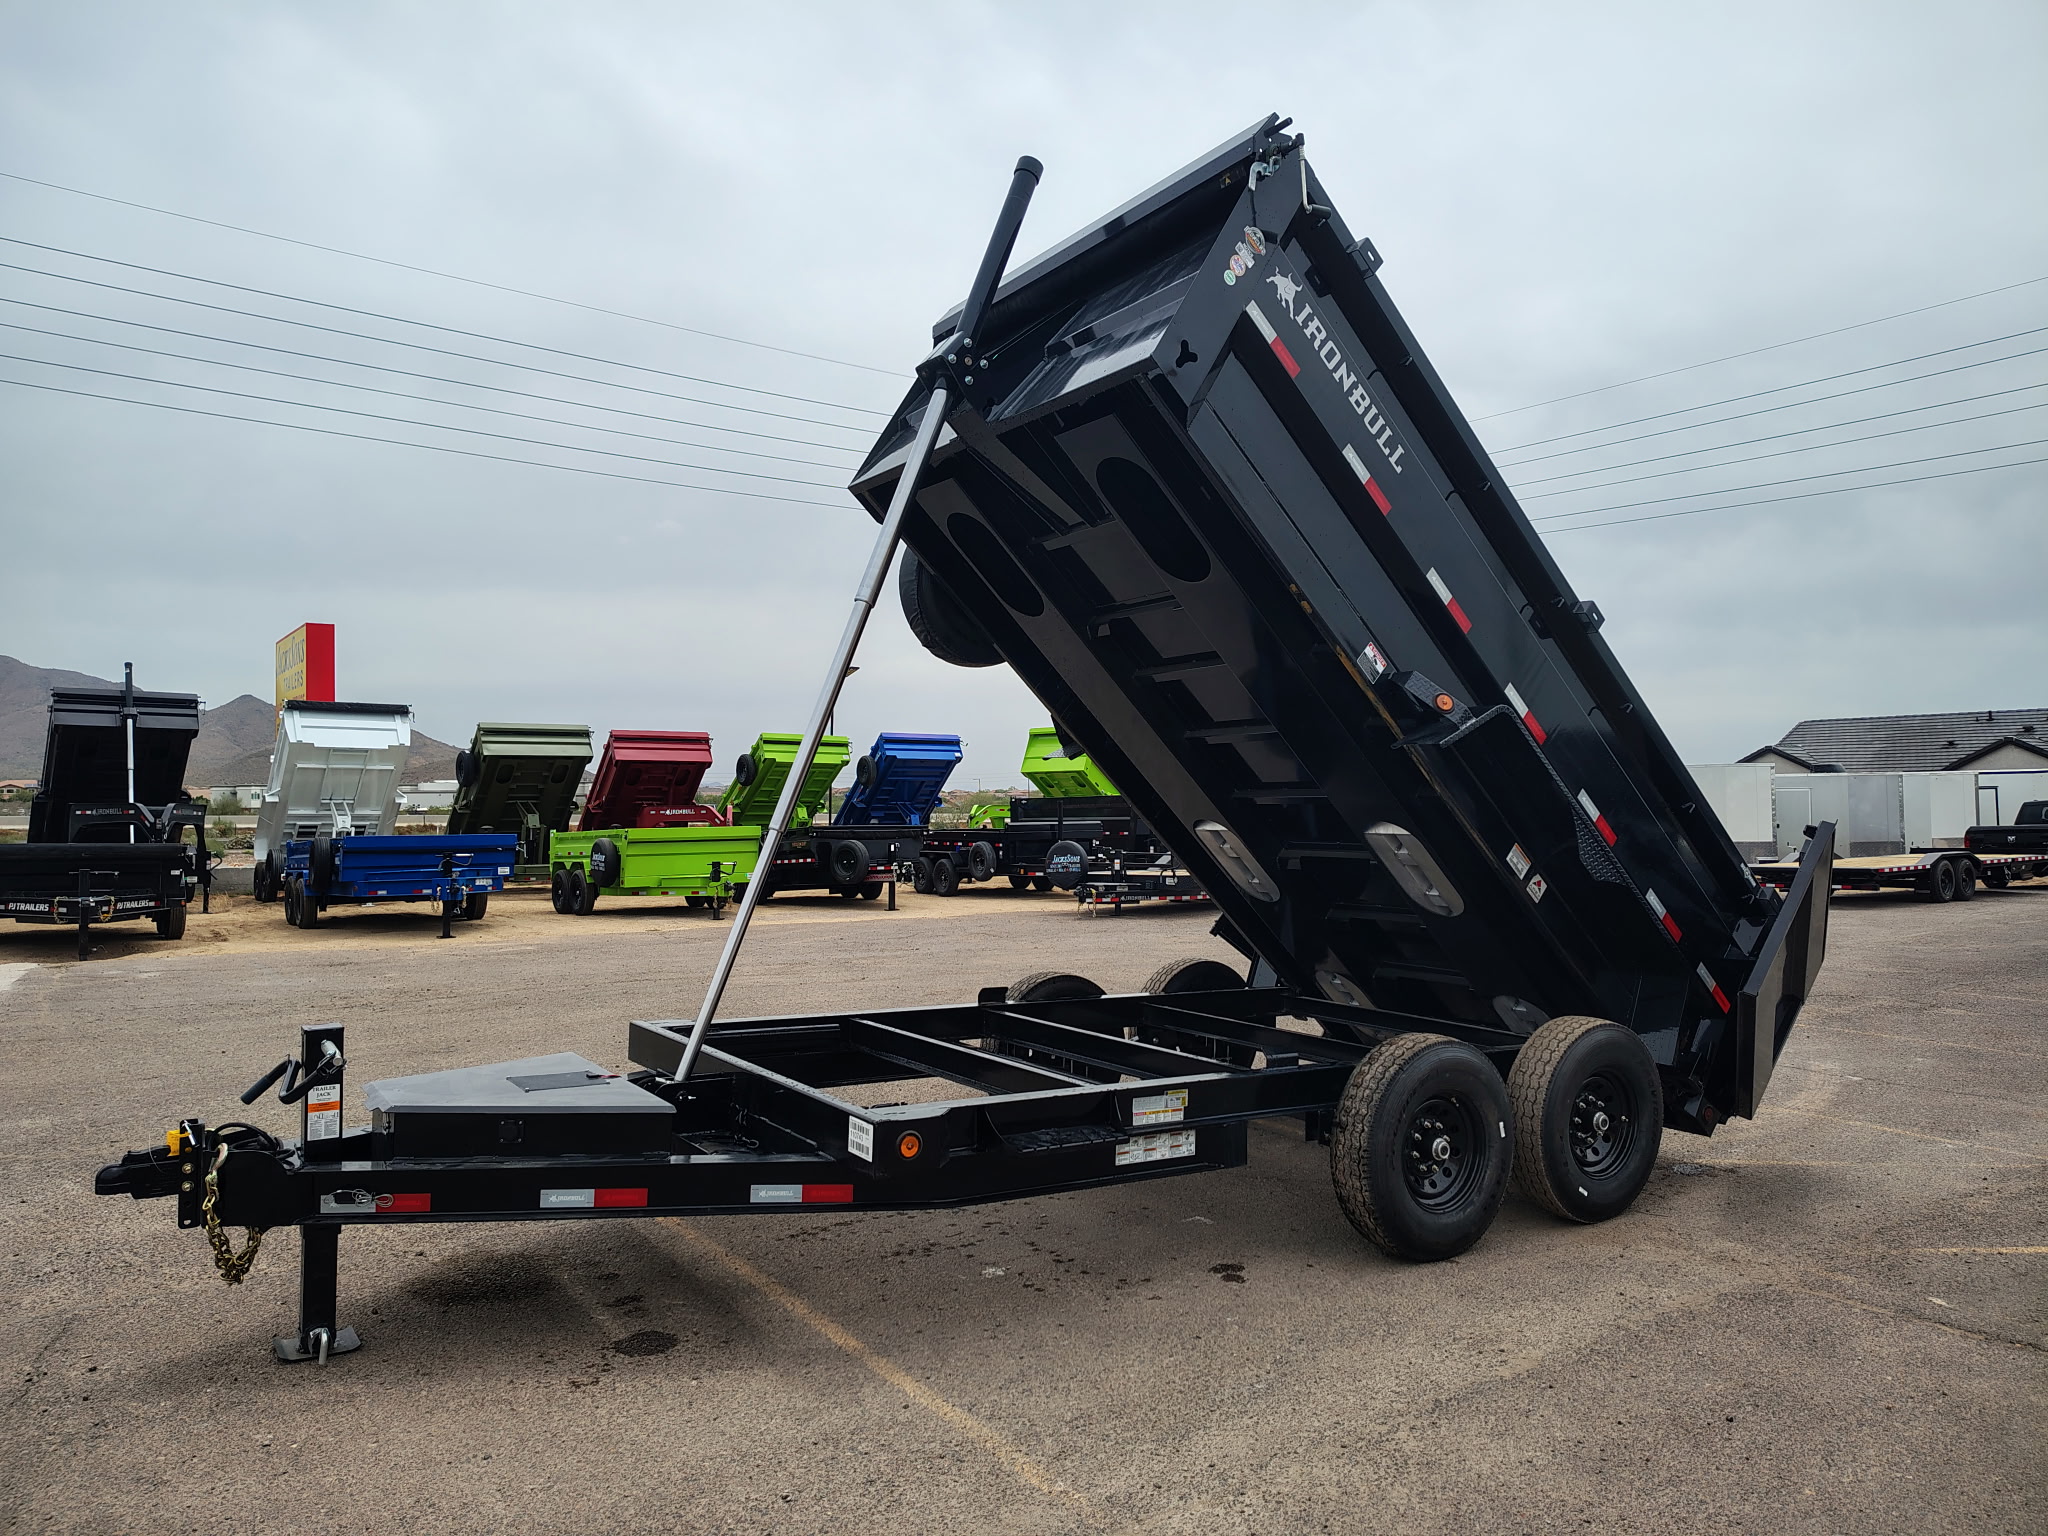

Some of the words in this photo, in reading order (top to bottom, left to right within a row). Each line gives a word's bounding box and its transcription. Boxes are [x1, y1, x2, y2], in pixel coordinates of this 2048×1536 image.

[1295, 303, 1405, 474] IRONBULL
[284, 670, 304, 691] TRAILERS
[16, 902, 49, 911] TRAILERS
[124, 899, 149, 908] TRAILERS
